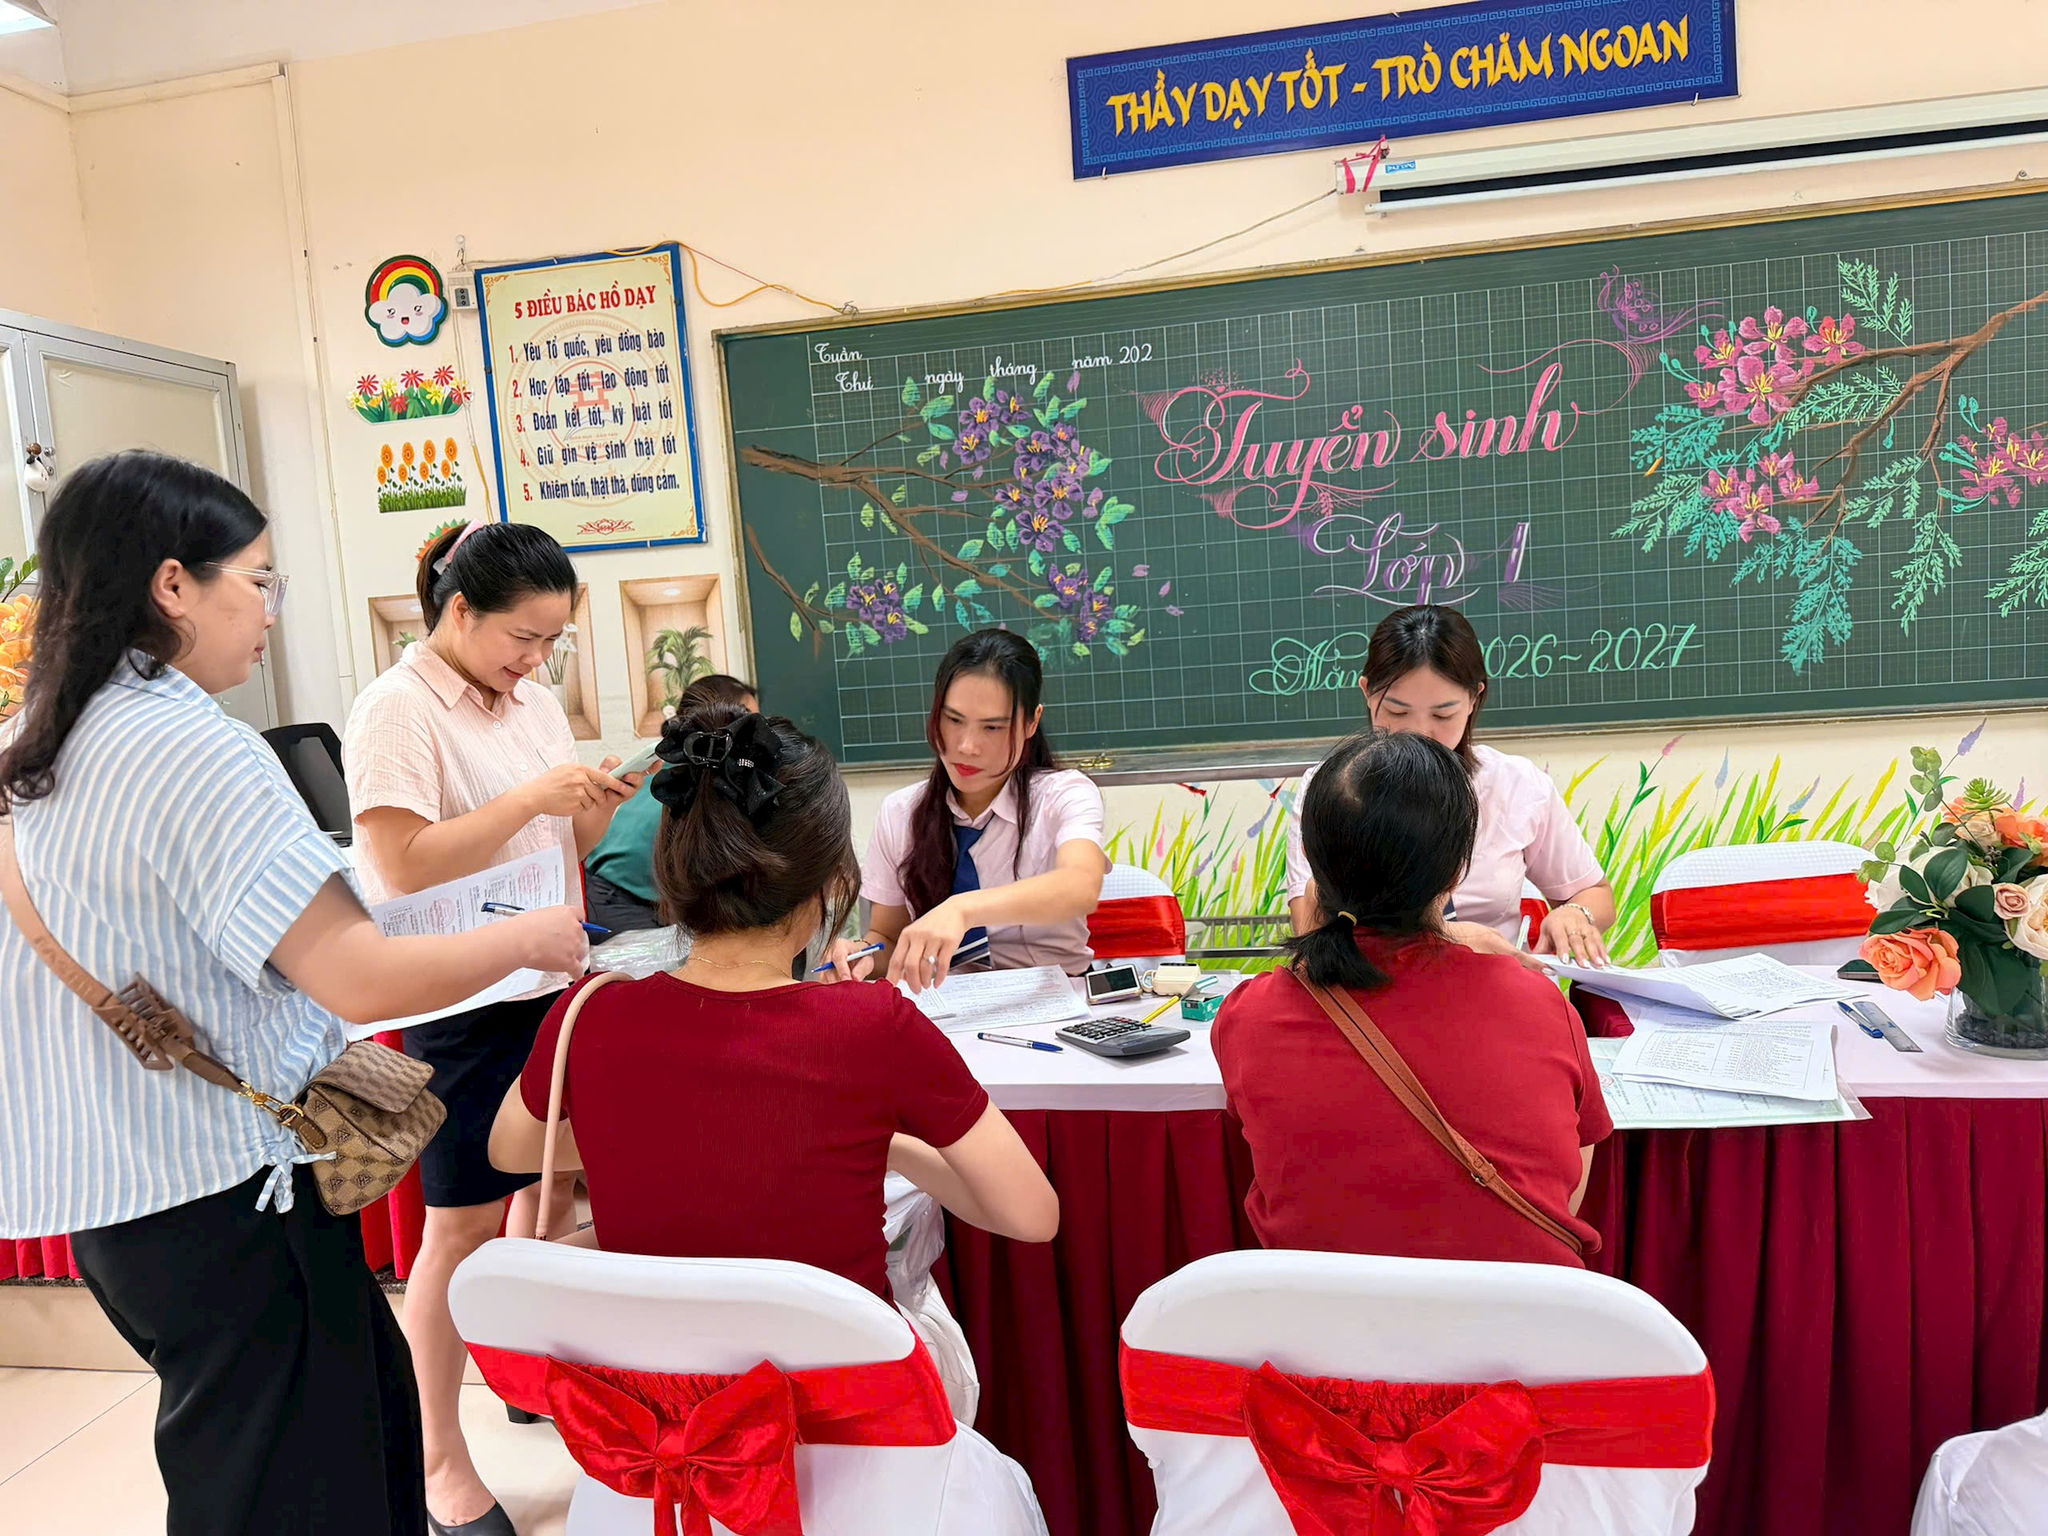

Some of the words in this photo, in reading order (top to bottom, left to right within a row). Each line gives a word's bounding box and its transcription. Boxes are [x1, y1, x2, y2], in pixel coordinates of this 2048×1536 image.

[1200, 71, 1274, 130] DẠY
[1276, 47, 1348, 114] TỐT
[1351, 82, 1368, 93] -
[1371, 40, 1442, 101] TRÒ
[1450, 31, 1554, 89] CHĂM
[1558, 13, 1689, 78] NGOAN
[514, 301, 523, 319] 5
[526, 288, 562, 318] ĐIỀU
[566, 288, 596, 313] BÁC
[599, 280, 620, 309] HỒ
[624, 285, 656, 309] DẠY
[509, 345, 518, 363] 1.
[523, 342, 541, 362] Yêu
[546, 335, 558, 360] Tổ
[563, 333, 590, 359] quốc,
[595, 334, 612, 357] yêu
[618, 328, 641, 352] đồng
[647, 328, 665, 349] bào
[814, 342, 862, 363] Tuần
[512, 379, 522, 398] 2.
[529, 377, 547, 400] Học
[554, 374, 570, 398] tập
[577, 369, 594, 393] tốt,
[600, 370, 617, 389] lao
[624, 367, 648, 391] động
[655, 361, 669, 384] tốt
[924, 370, 964, 394] ngày
[990, 356, 1037, 385] tháng
[1072, 355, 1113, 370] năm
[1119, 343, 1153, 364] 202
[515, 414, 526, 433] 3.
[532, 410, 557, 431] Đoàn
[564, 405, 581, 428] kết
[587, 403, 605, 427] tốt,
[612, 402, 624, 425] kỷ
[631, 401, 652, 425] luật
[658, 396, 672, 419] tốt
[520, 448, 530, 467] 4.
[537, 444, 554, 466] Giữ
[561, 444, 578, 466] gìn
[585, 442, 597, 465] vệ
[605, 440, 627, 460] sinh
[634, 437, 655, 460] thật
[661, 432, 677, 455] tốt
[1155, 360, 1401, 529] Tuyển
[1410, 362, 1580, 462] sinh
[523, 483, 533, 501] 5.
[539, 479, 569, 500] Khiêm
[571, 475, 589, 498] tốn,
[590, 475, 610, 499] thật
[611, 474, 629, 495] thà,
[630, 473, 654, 493] dũng
[656, 469, 680, 489] cảm.
[1306, 512, 1478, 606] Lớp
[1502, 522, 1530, 583] 1
